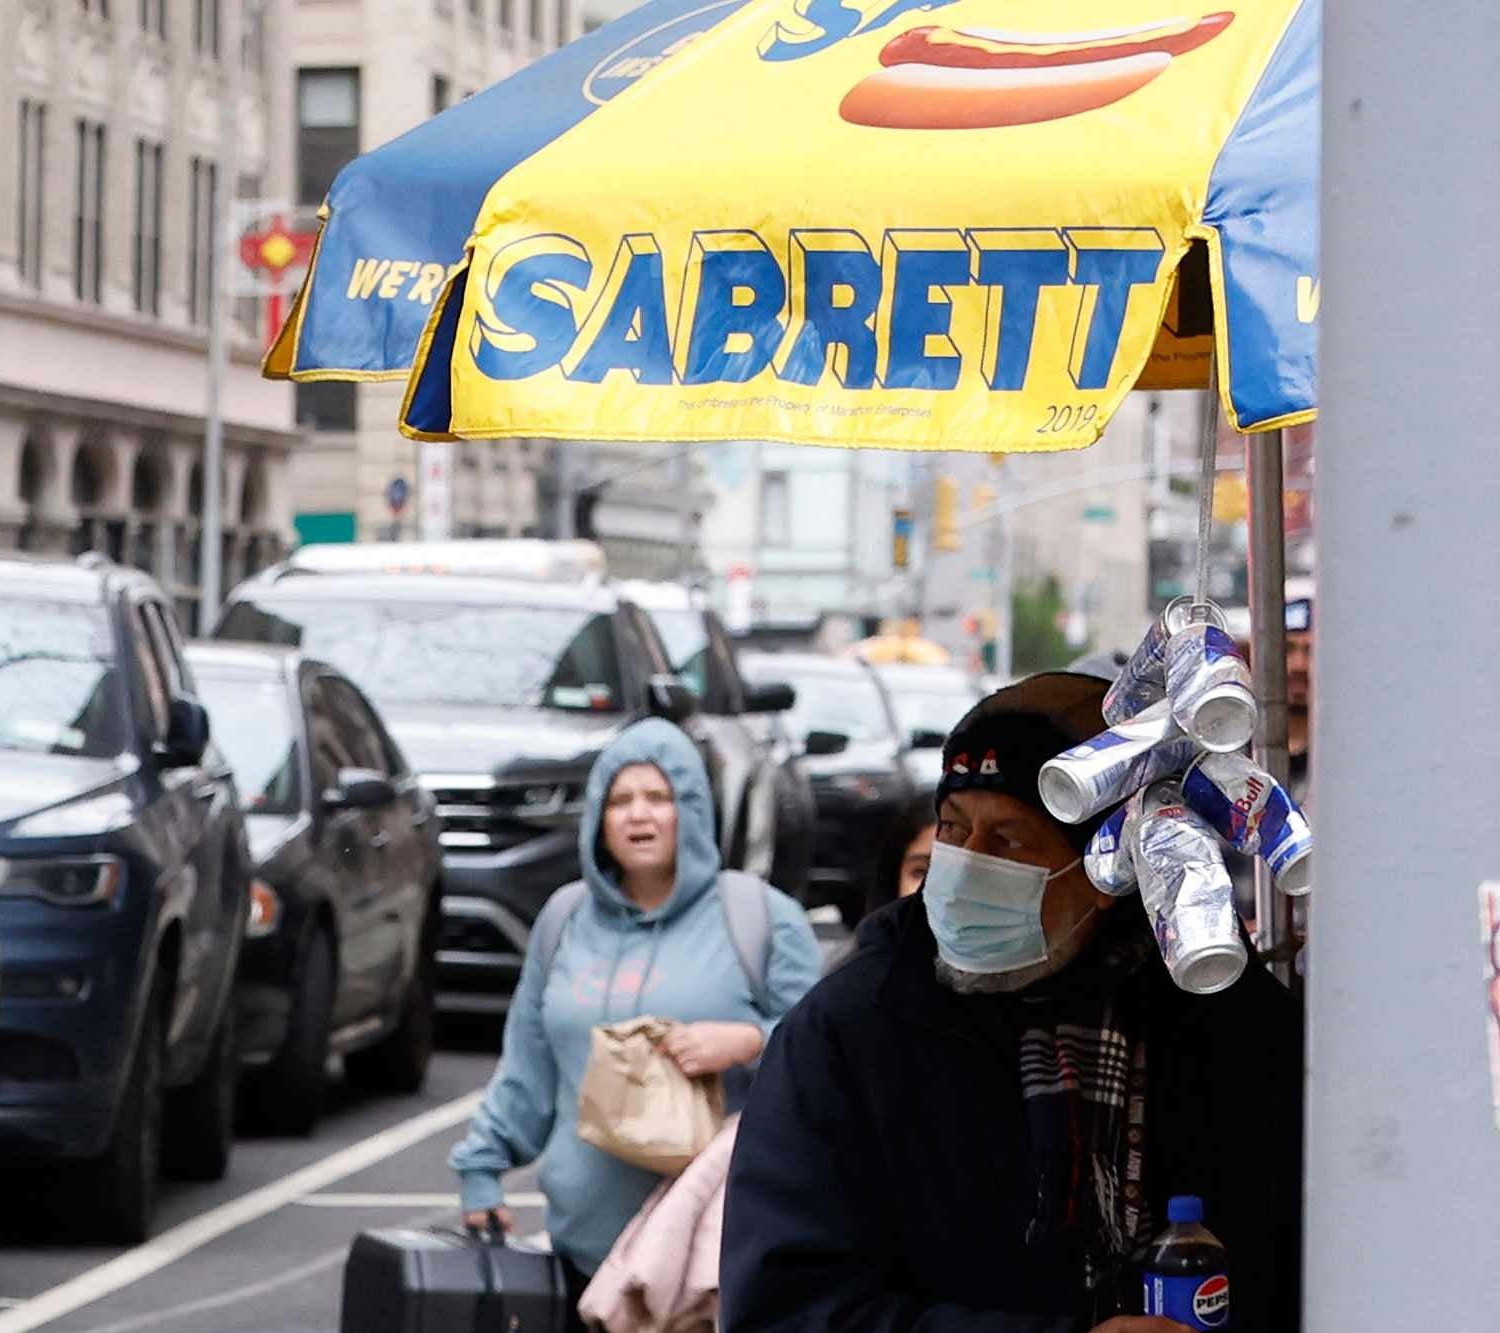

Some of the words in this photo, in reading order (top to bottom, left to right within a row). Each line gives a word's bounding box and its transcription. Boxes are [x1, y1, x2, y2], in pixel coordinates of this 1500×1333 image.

[347, 258, 456, 304] WE'R
[473, 227, 1164, 390] SABRETT
[1036, 403, 1098, 434] 2019
[1233, 776, 1265, 812] Bull
[1196, 1291, 1229, 1309] PEPS
